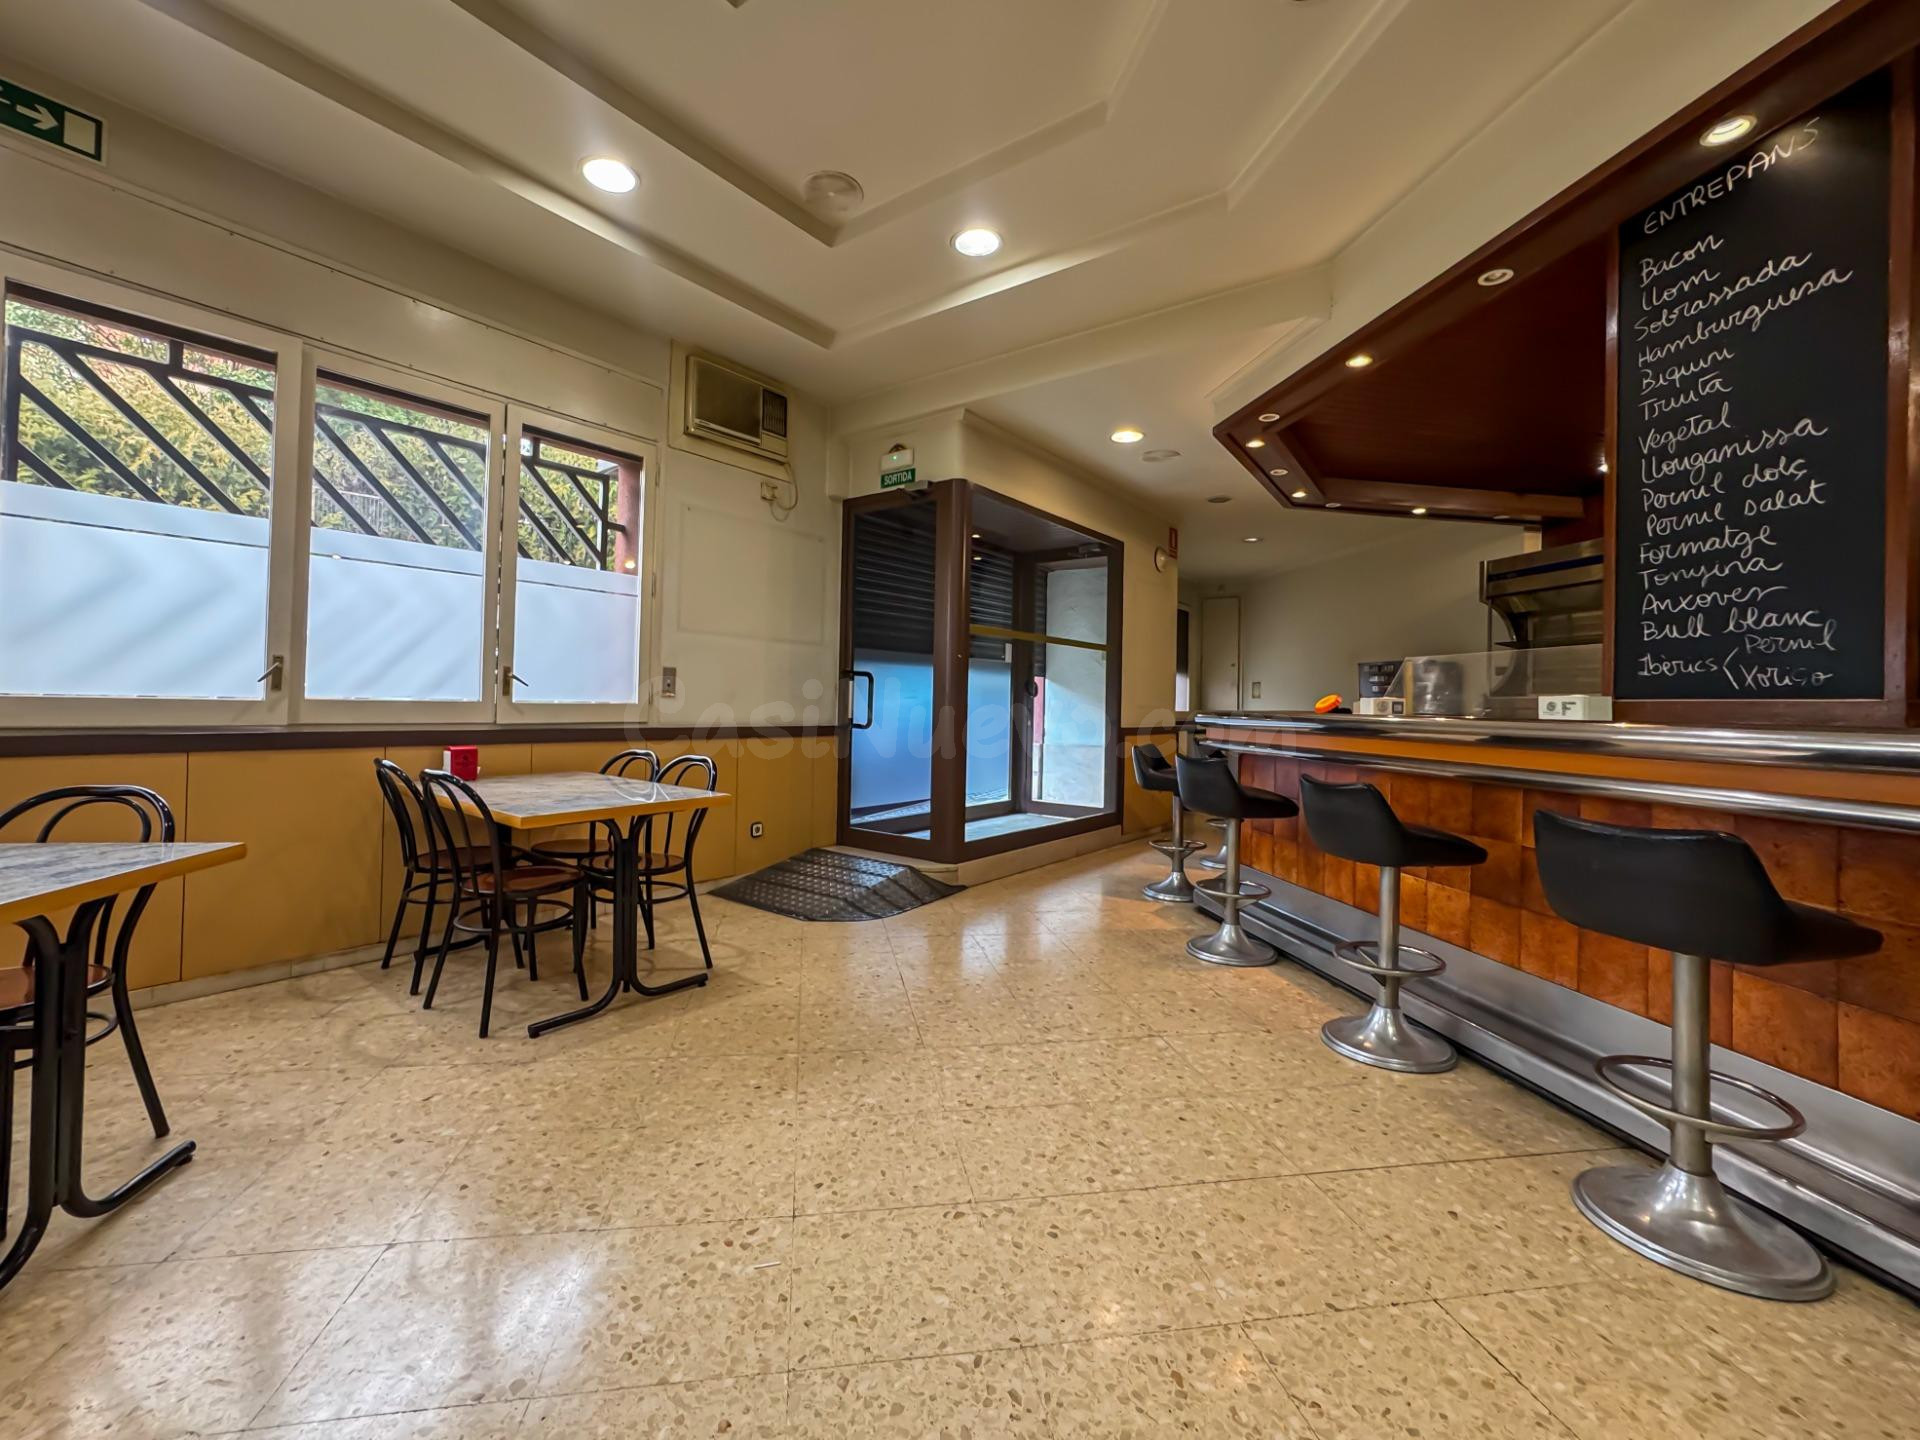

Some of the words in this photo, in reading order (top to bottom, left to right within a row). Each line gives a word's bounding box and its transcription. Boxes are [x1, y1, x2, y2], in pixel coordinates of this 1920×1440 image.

[1644, 116, 1820, 234] ENTREPANS
[1639, 234, 1724, 288] Bacon
[1634, 252, 1812, 341] Sobrassada
[1638, 269, 1853, 367] Hamburguesa
[1638, 401, 1732, 454] Vegetal
[884, 471, 913, 486] SORTIDA
[1640, 525, 1777, 564] Formatge
[1641, 613, 1711, 641] Bull
[1723, 607, 1823, 634] blanc
